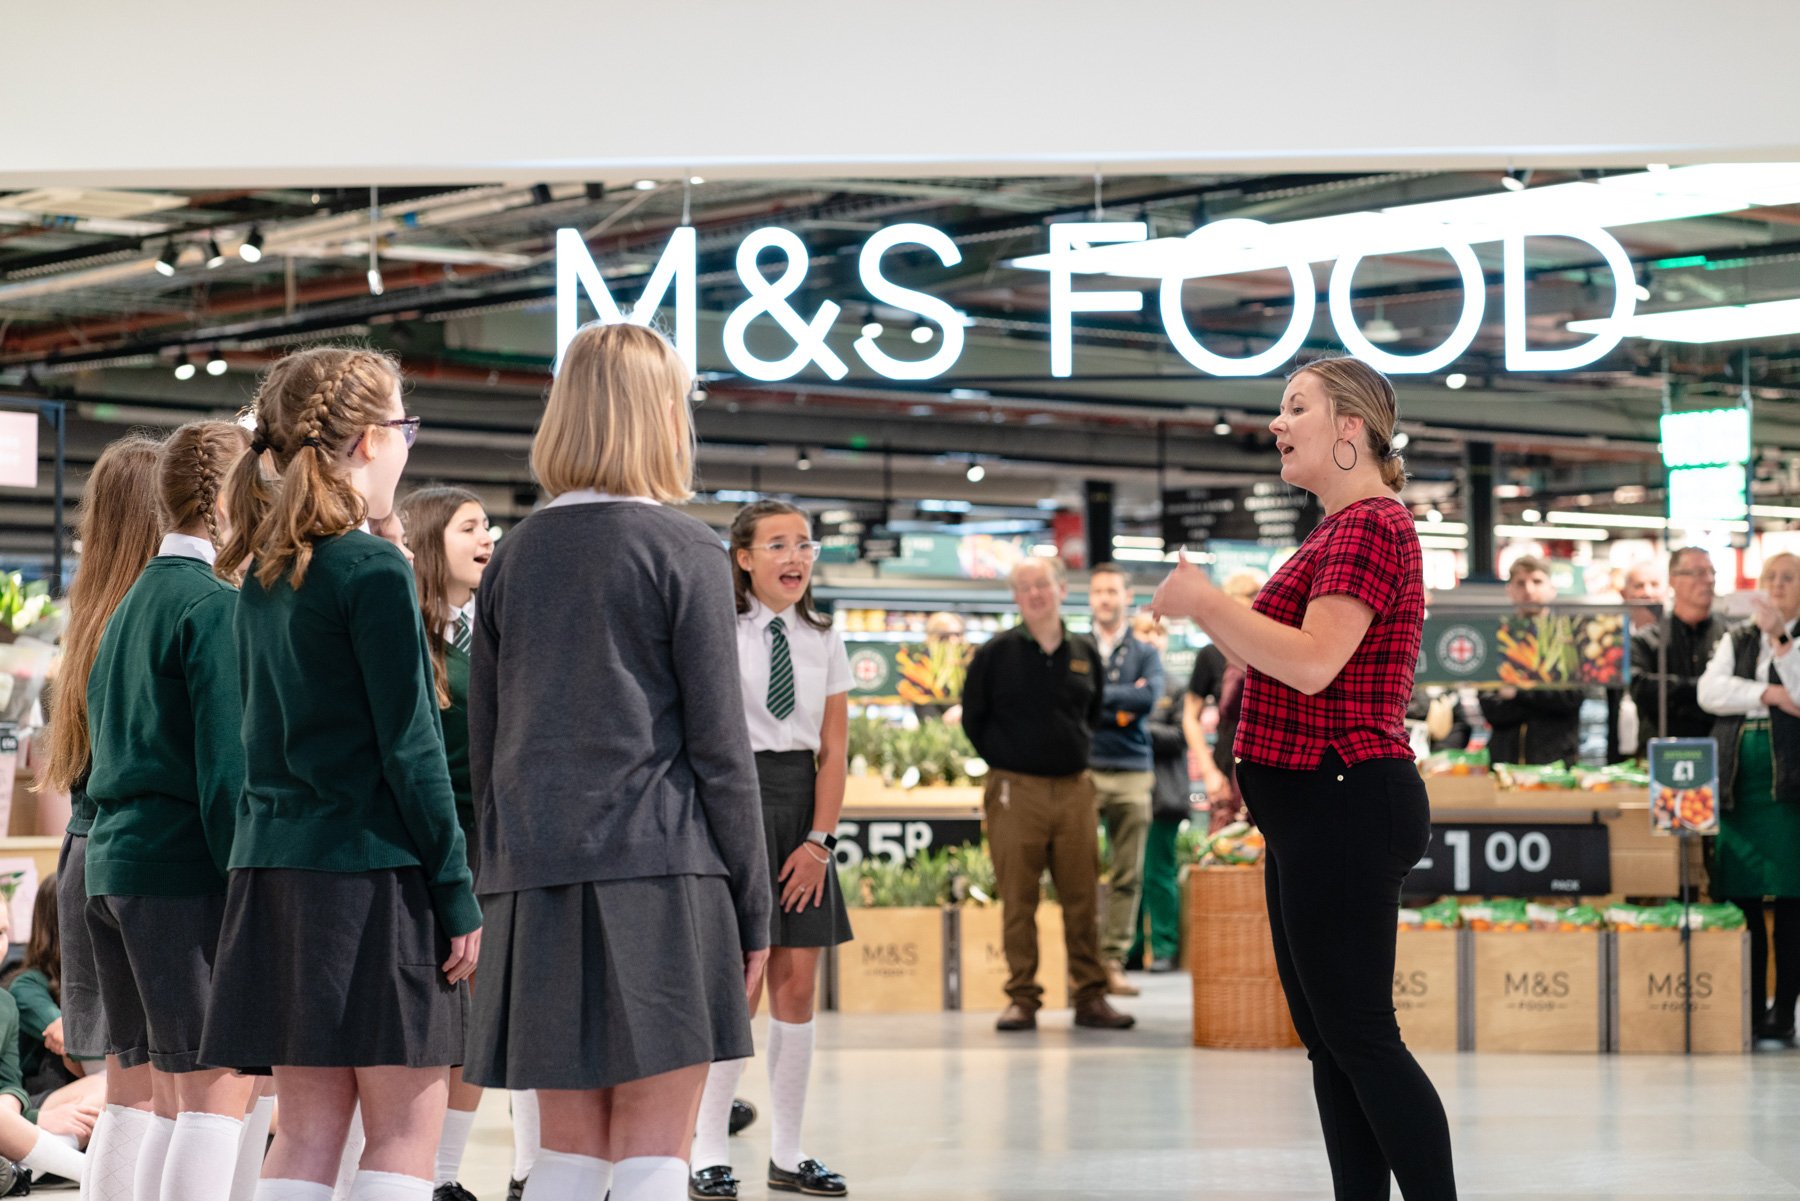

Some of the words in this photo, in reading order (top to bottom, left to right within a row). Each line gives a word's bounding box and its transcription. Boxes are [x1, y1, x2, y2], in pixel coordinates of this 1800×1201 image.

[555, 222, 966, 381] M&S
[1049, 217, 1637, 378] FOOD
[861, 942, 920, 967] M&S
[1393, 970, 1429, 997] &S
[1503, 970, 1570, 999] M&S
[1647, 971, 1714, 1000] M&S
